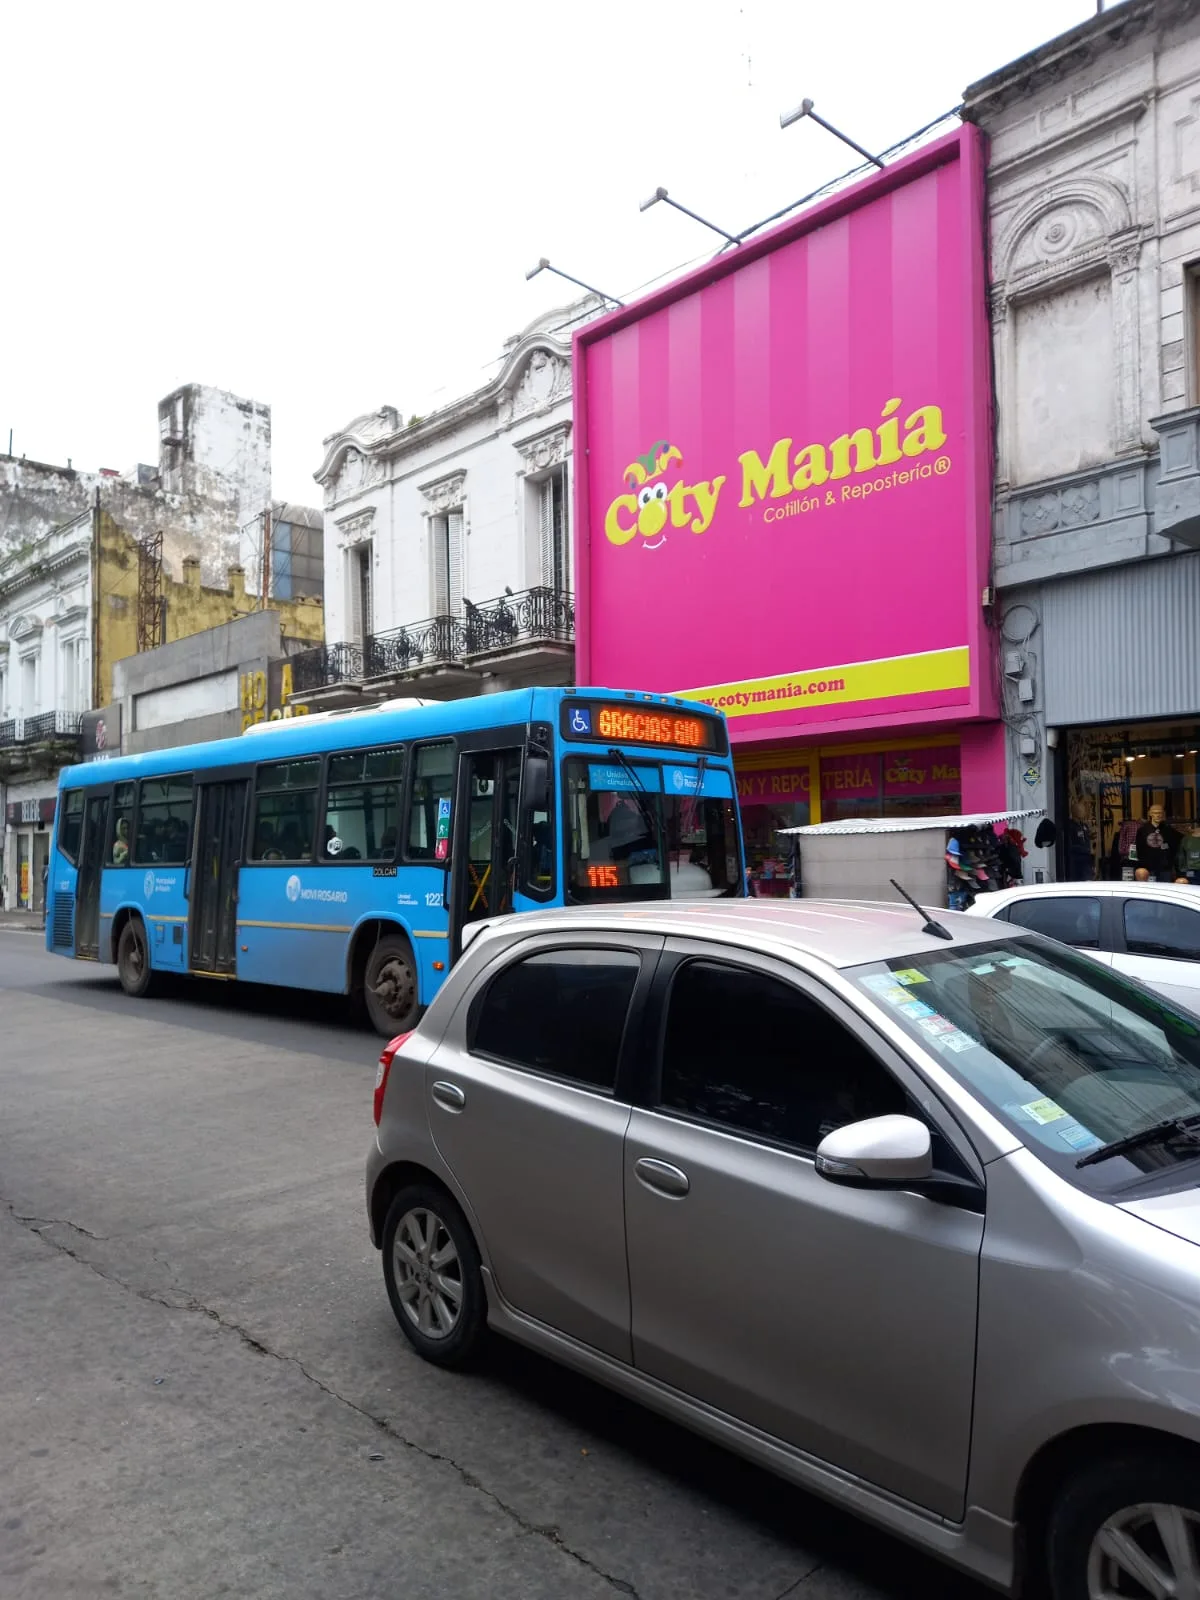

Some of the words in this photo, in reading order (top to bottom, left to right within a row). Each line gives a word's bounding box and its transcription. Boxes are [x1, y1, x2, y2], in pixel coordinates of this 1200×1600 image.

[604, 475, 726, 545] Coty
[738, 397, 947, 508] Manía
[763, 495, 820, 523] Cotillón
[825, 491, 836, 505] &
[698, 678, 845, 707] w.cotymanía.com
[932, 764, 961, 780] Ma
[373, 867, 397, 877] COLCAR
[587, 866, 618, 887] 115
